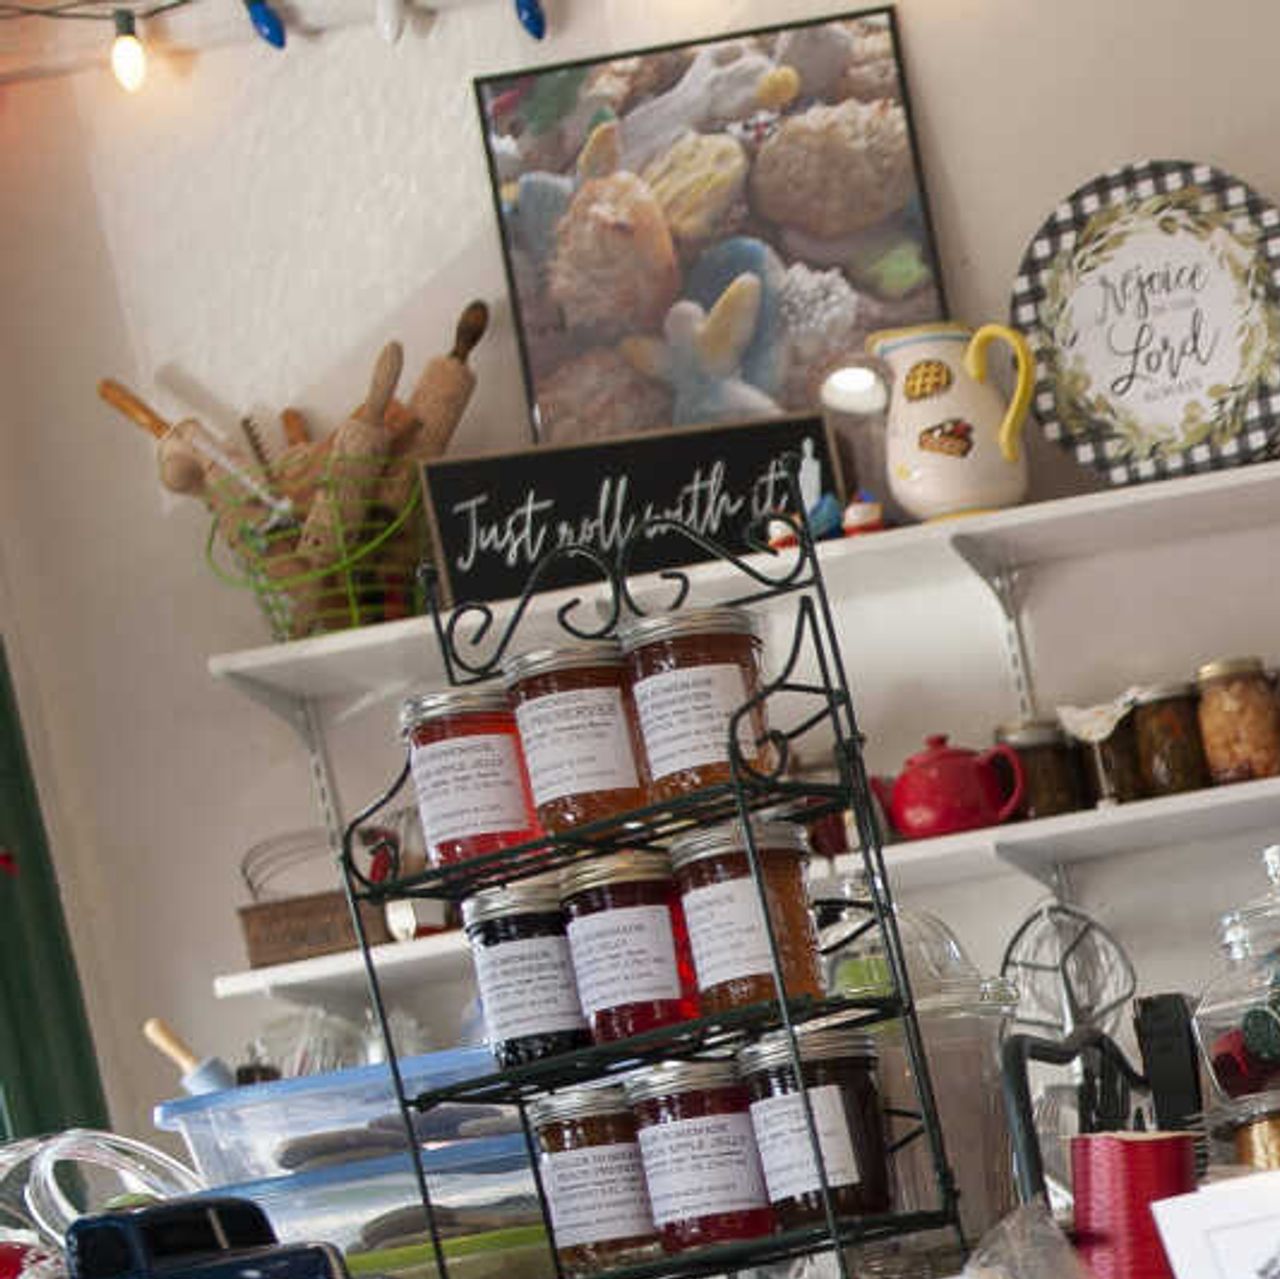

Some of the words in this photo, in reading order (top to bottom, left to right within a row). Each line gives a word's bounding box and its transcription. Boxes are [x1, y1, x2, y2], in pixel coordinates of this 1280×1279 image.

[1107, 307, 1221, 396] Lord
[451, 488, 555, 572] Just
[555, 475, 636, 553] roll
[643, 460, 745, 536] with
